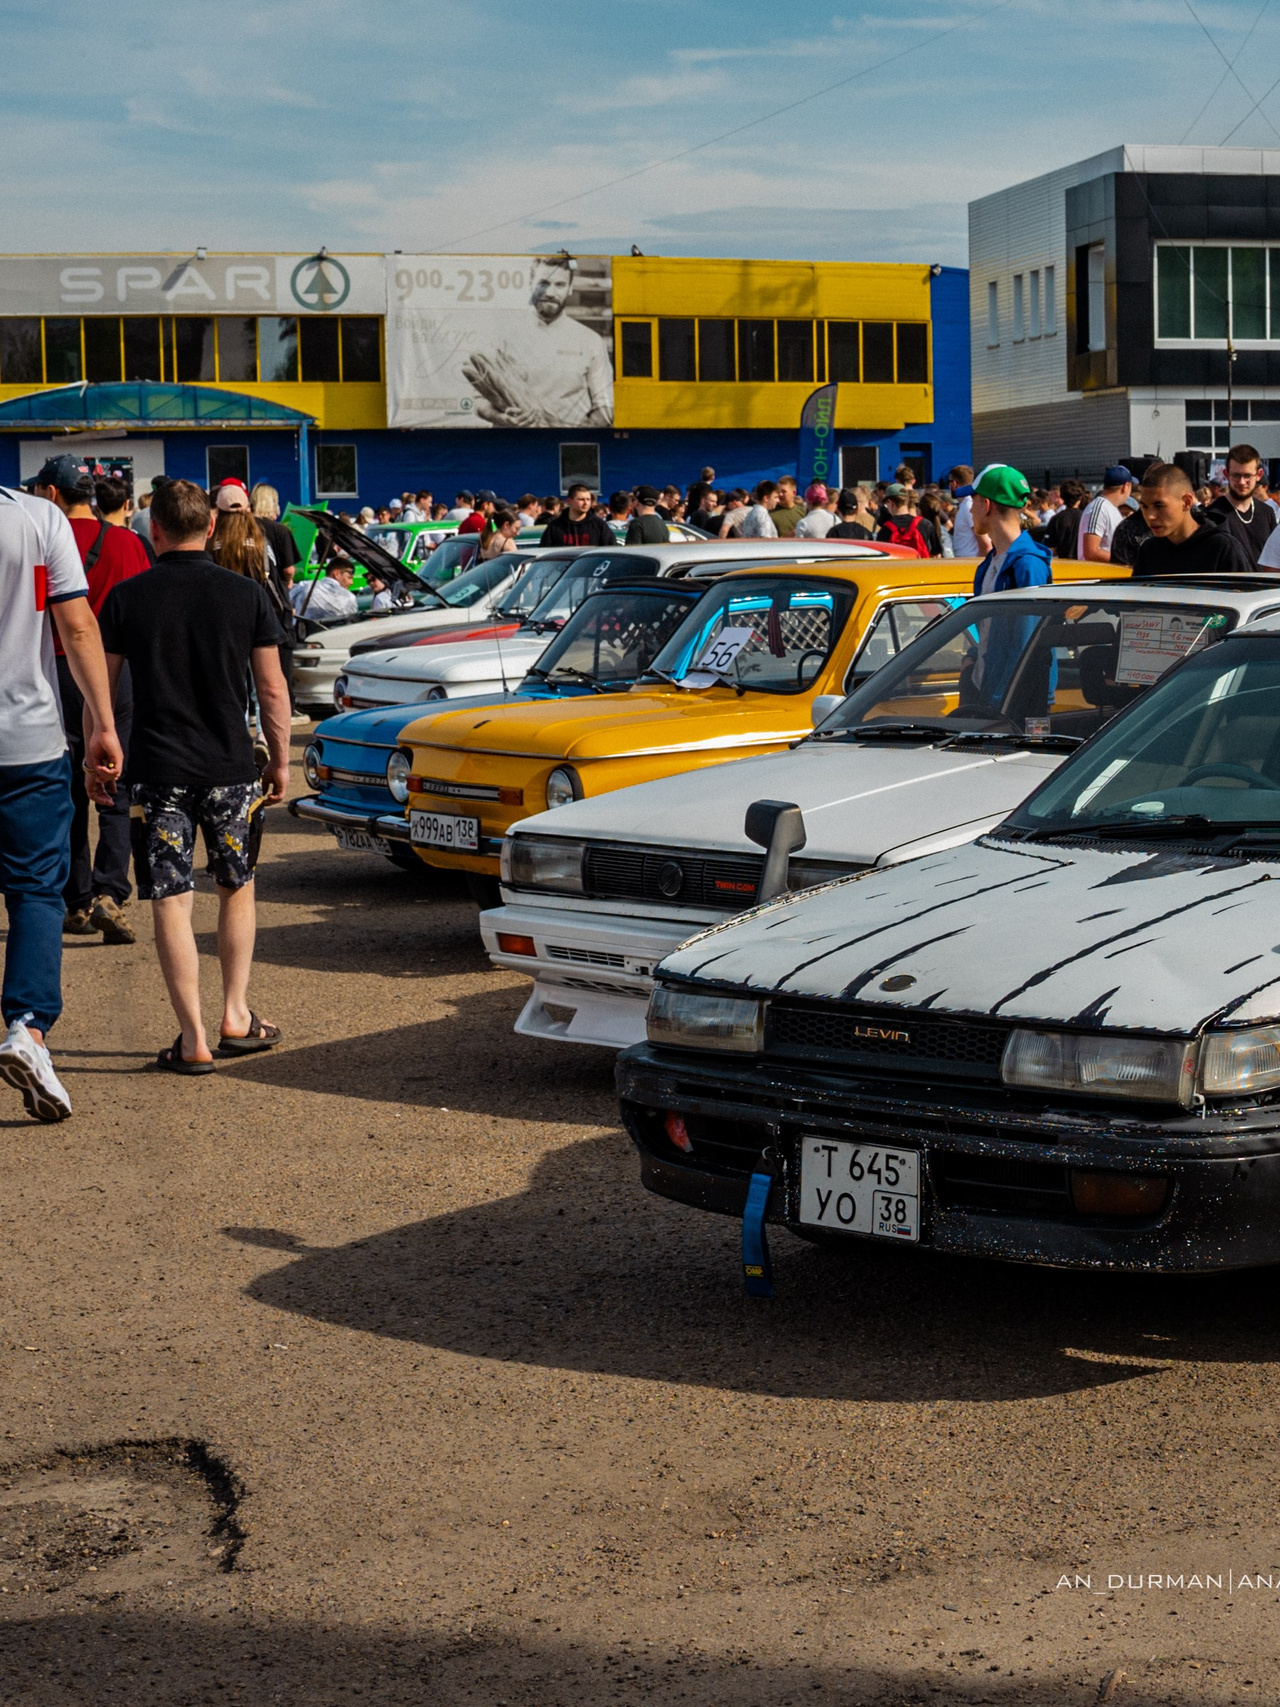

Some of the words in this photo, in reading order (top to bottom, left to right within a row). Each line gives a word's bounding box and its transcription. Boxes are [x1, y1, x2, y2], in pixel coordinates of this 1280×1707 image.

[59, 265, 271, 302] SPAR
[701, 641, 740, 668] 56
[715, 880, 736, 891] TWIN
[736, 883, 755, 892] CAM
[854, 1026, 910, 1042] LEVIN
[849, 1149, 900, 1187] 645
[880, 1196, 907, 1224] 38
[879, 1222, 897, 1233] RUS
